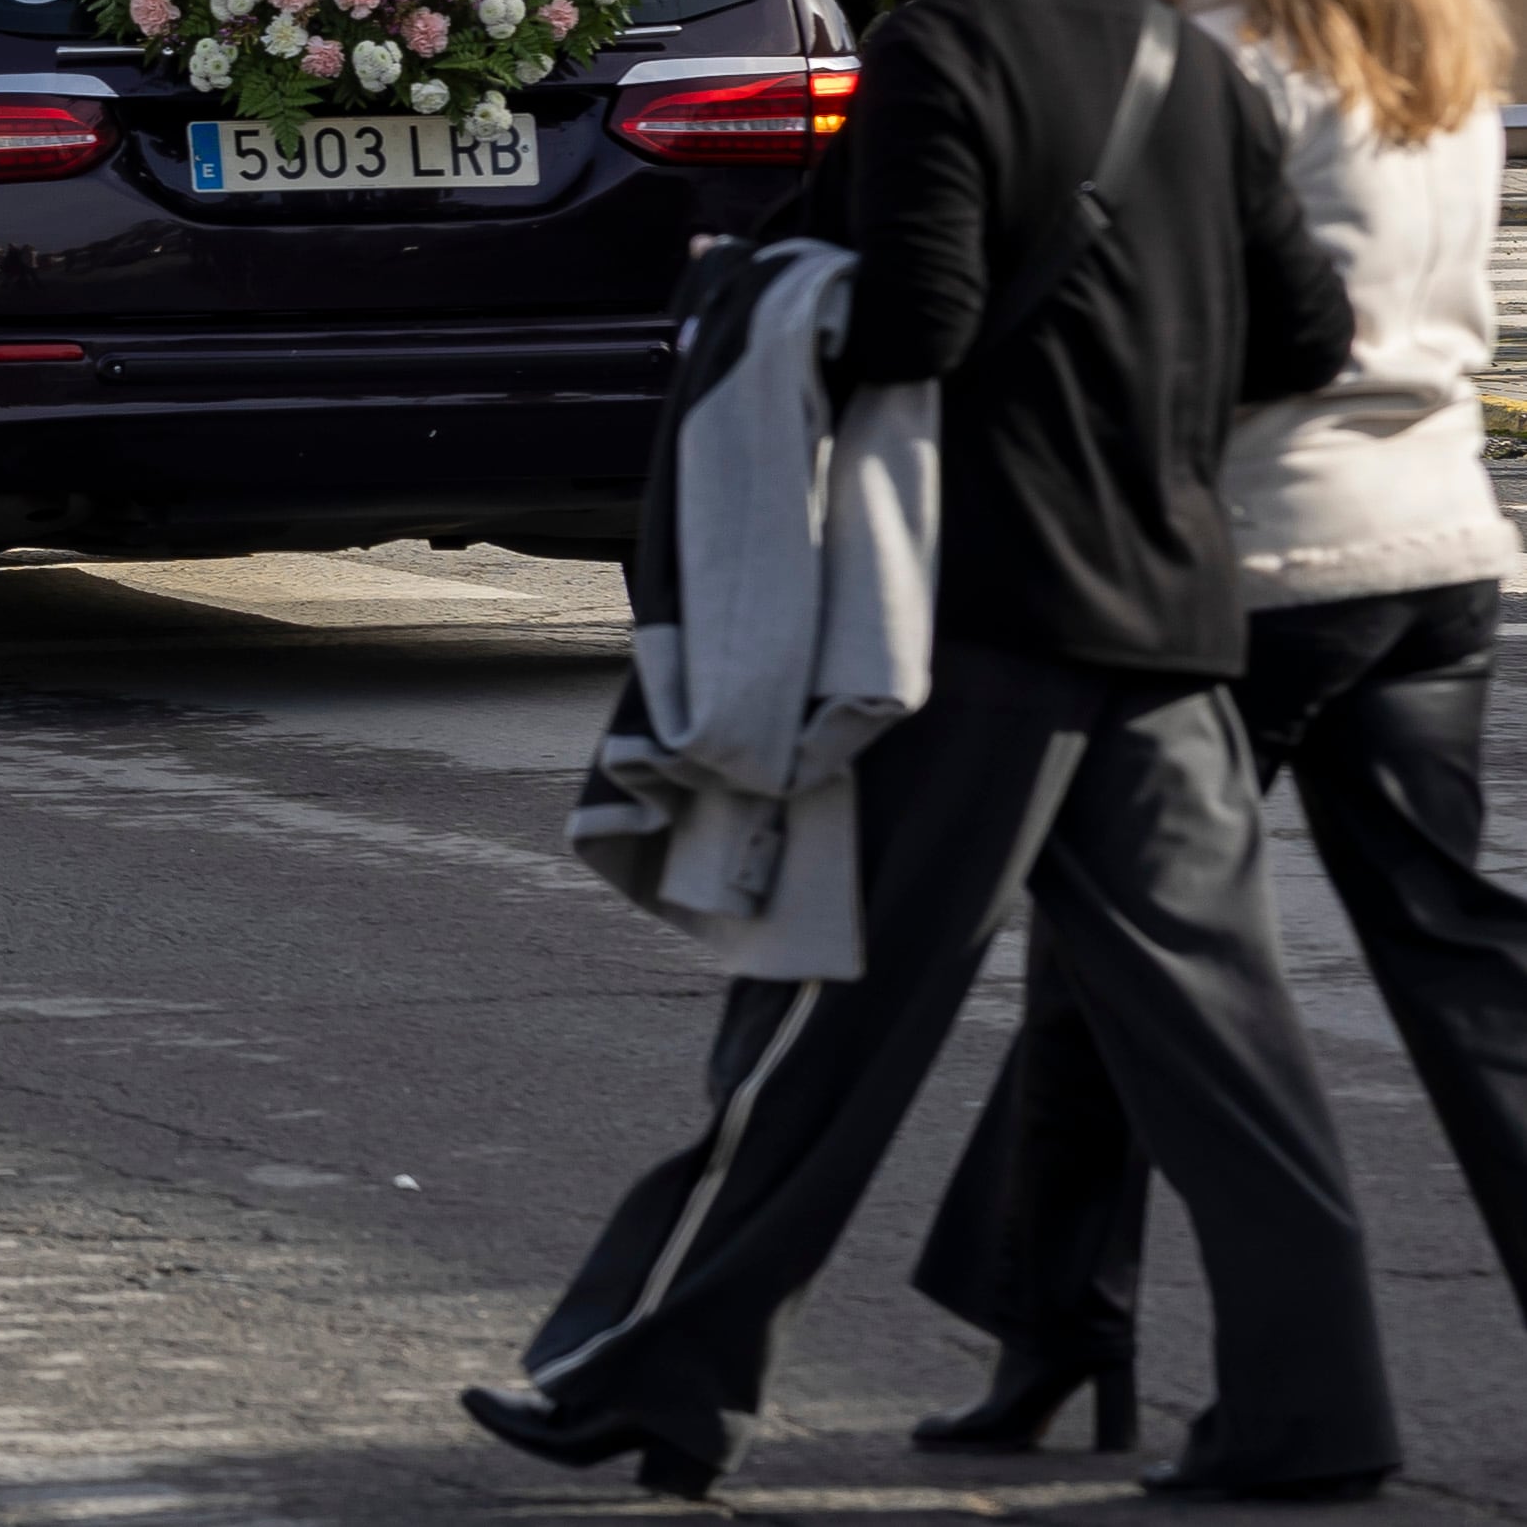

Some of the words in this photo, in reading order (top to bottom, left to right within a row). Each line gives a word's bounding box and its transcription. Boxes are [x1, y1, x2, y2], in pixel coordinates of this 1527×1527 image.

[202, 163, 215, 178] E
[233, 126, 386, 181] 5903
[410, 124, 523, 177] LRB
